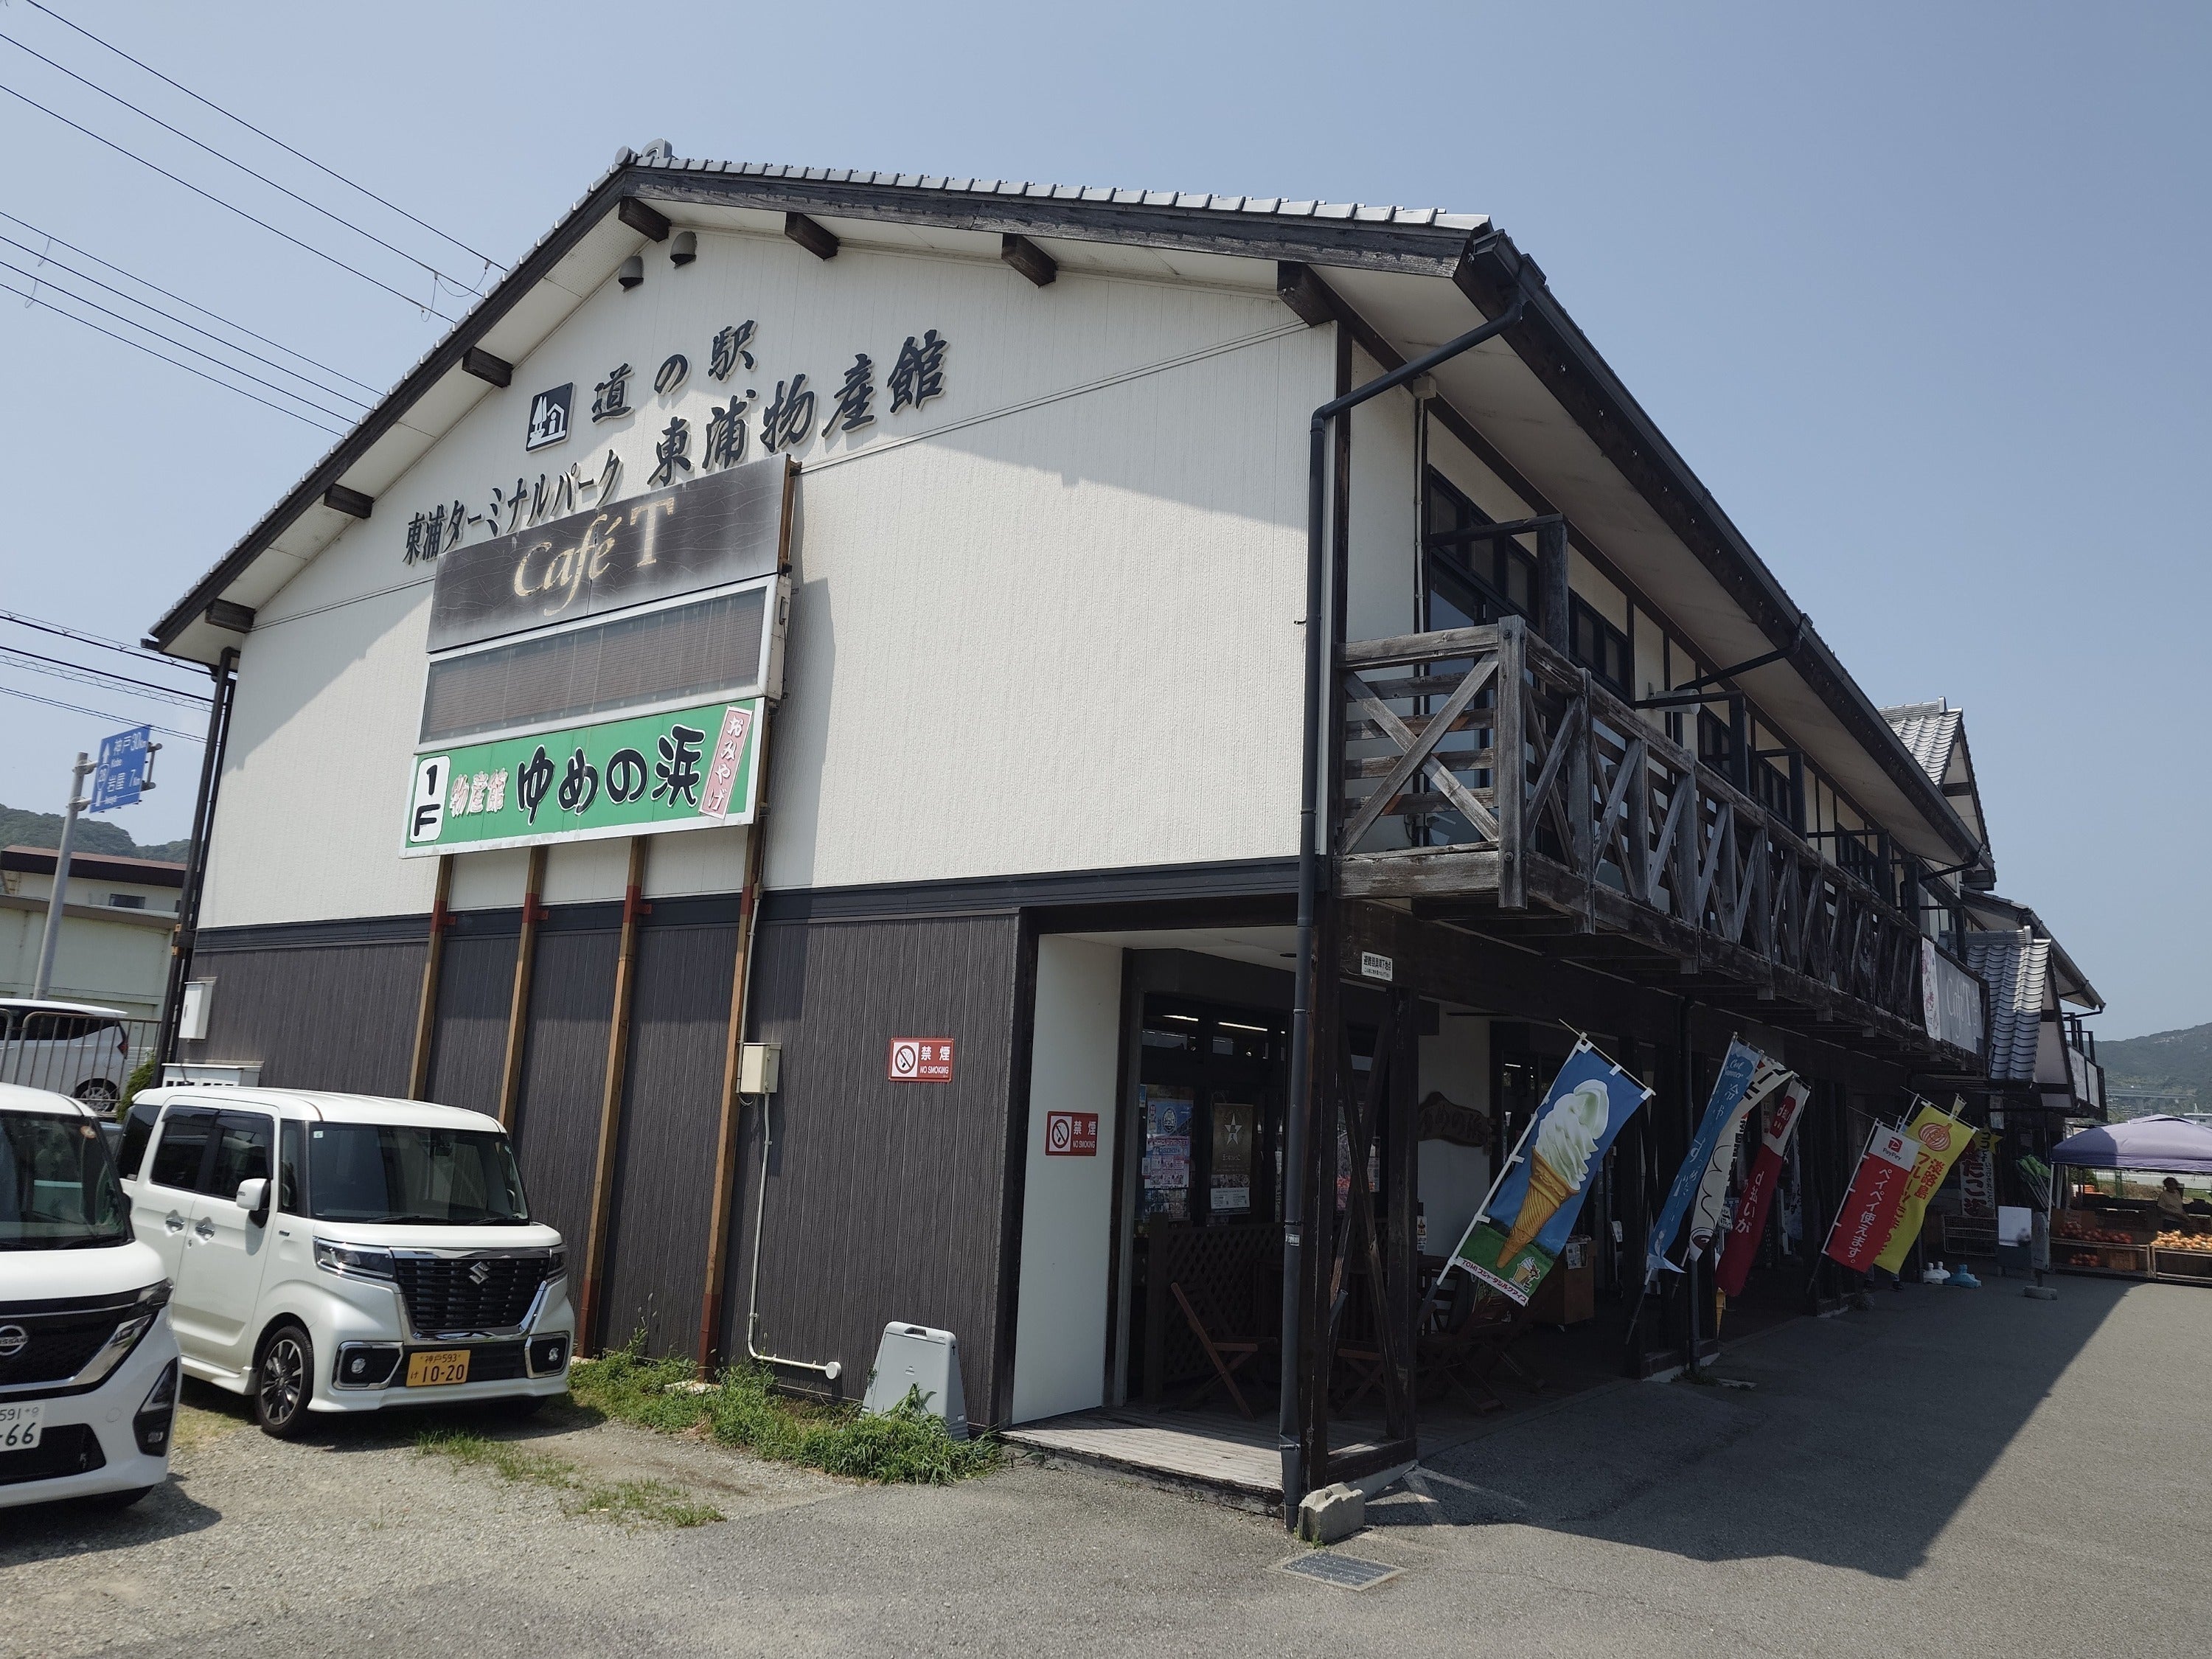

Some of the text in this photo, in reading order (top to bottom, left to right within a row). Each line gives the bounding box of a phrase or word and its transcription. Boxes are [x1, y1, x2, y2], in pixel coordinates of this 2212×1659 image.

[591, 320, 757, 424] 道の駅
[403, 329, 949, 566] 東浦ターミナルパーク 東浦物産館
[514, 498, 674, 616] Café T
[114, 736, 131, 755] 神戸
[707, 714, 745, 810] おみやげ
[107, 772, 126, 793] 岩屋
[518, 725, 705, 826] ゆめの浜
[414, 764, 442, 837] 1F
[921, 1046, 950, 1061] 禁煙
[919, 1065, 949, 1074] NO SMOKING
[1073, 1120, 1096, 1135] 禁煙
[1072, 1140, 1095, 1149] NO SMOKING
[1882, 1148, 1902, 1161] PayPay
[1914, 1158, 1945, 1200] 淡路島
[1848, 1168, 1893, 1263] ペイペイ使えます。
[0, 1336, 28, 1345] ISSAN
[422, 1364, 465, 1382] 10-20
